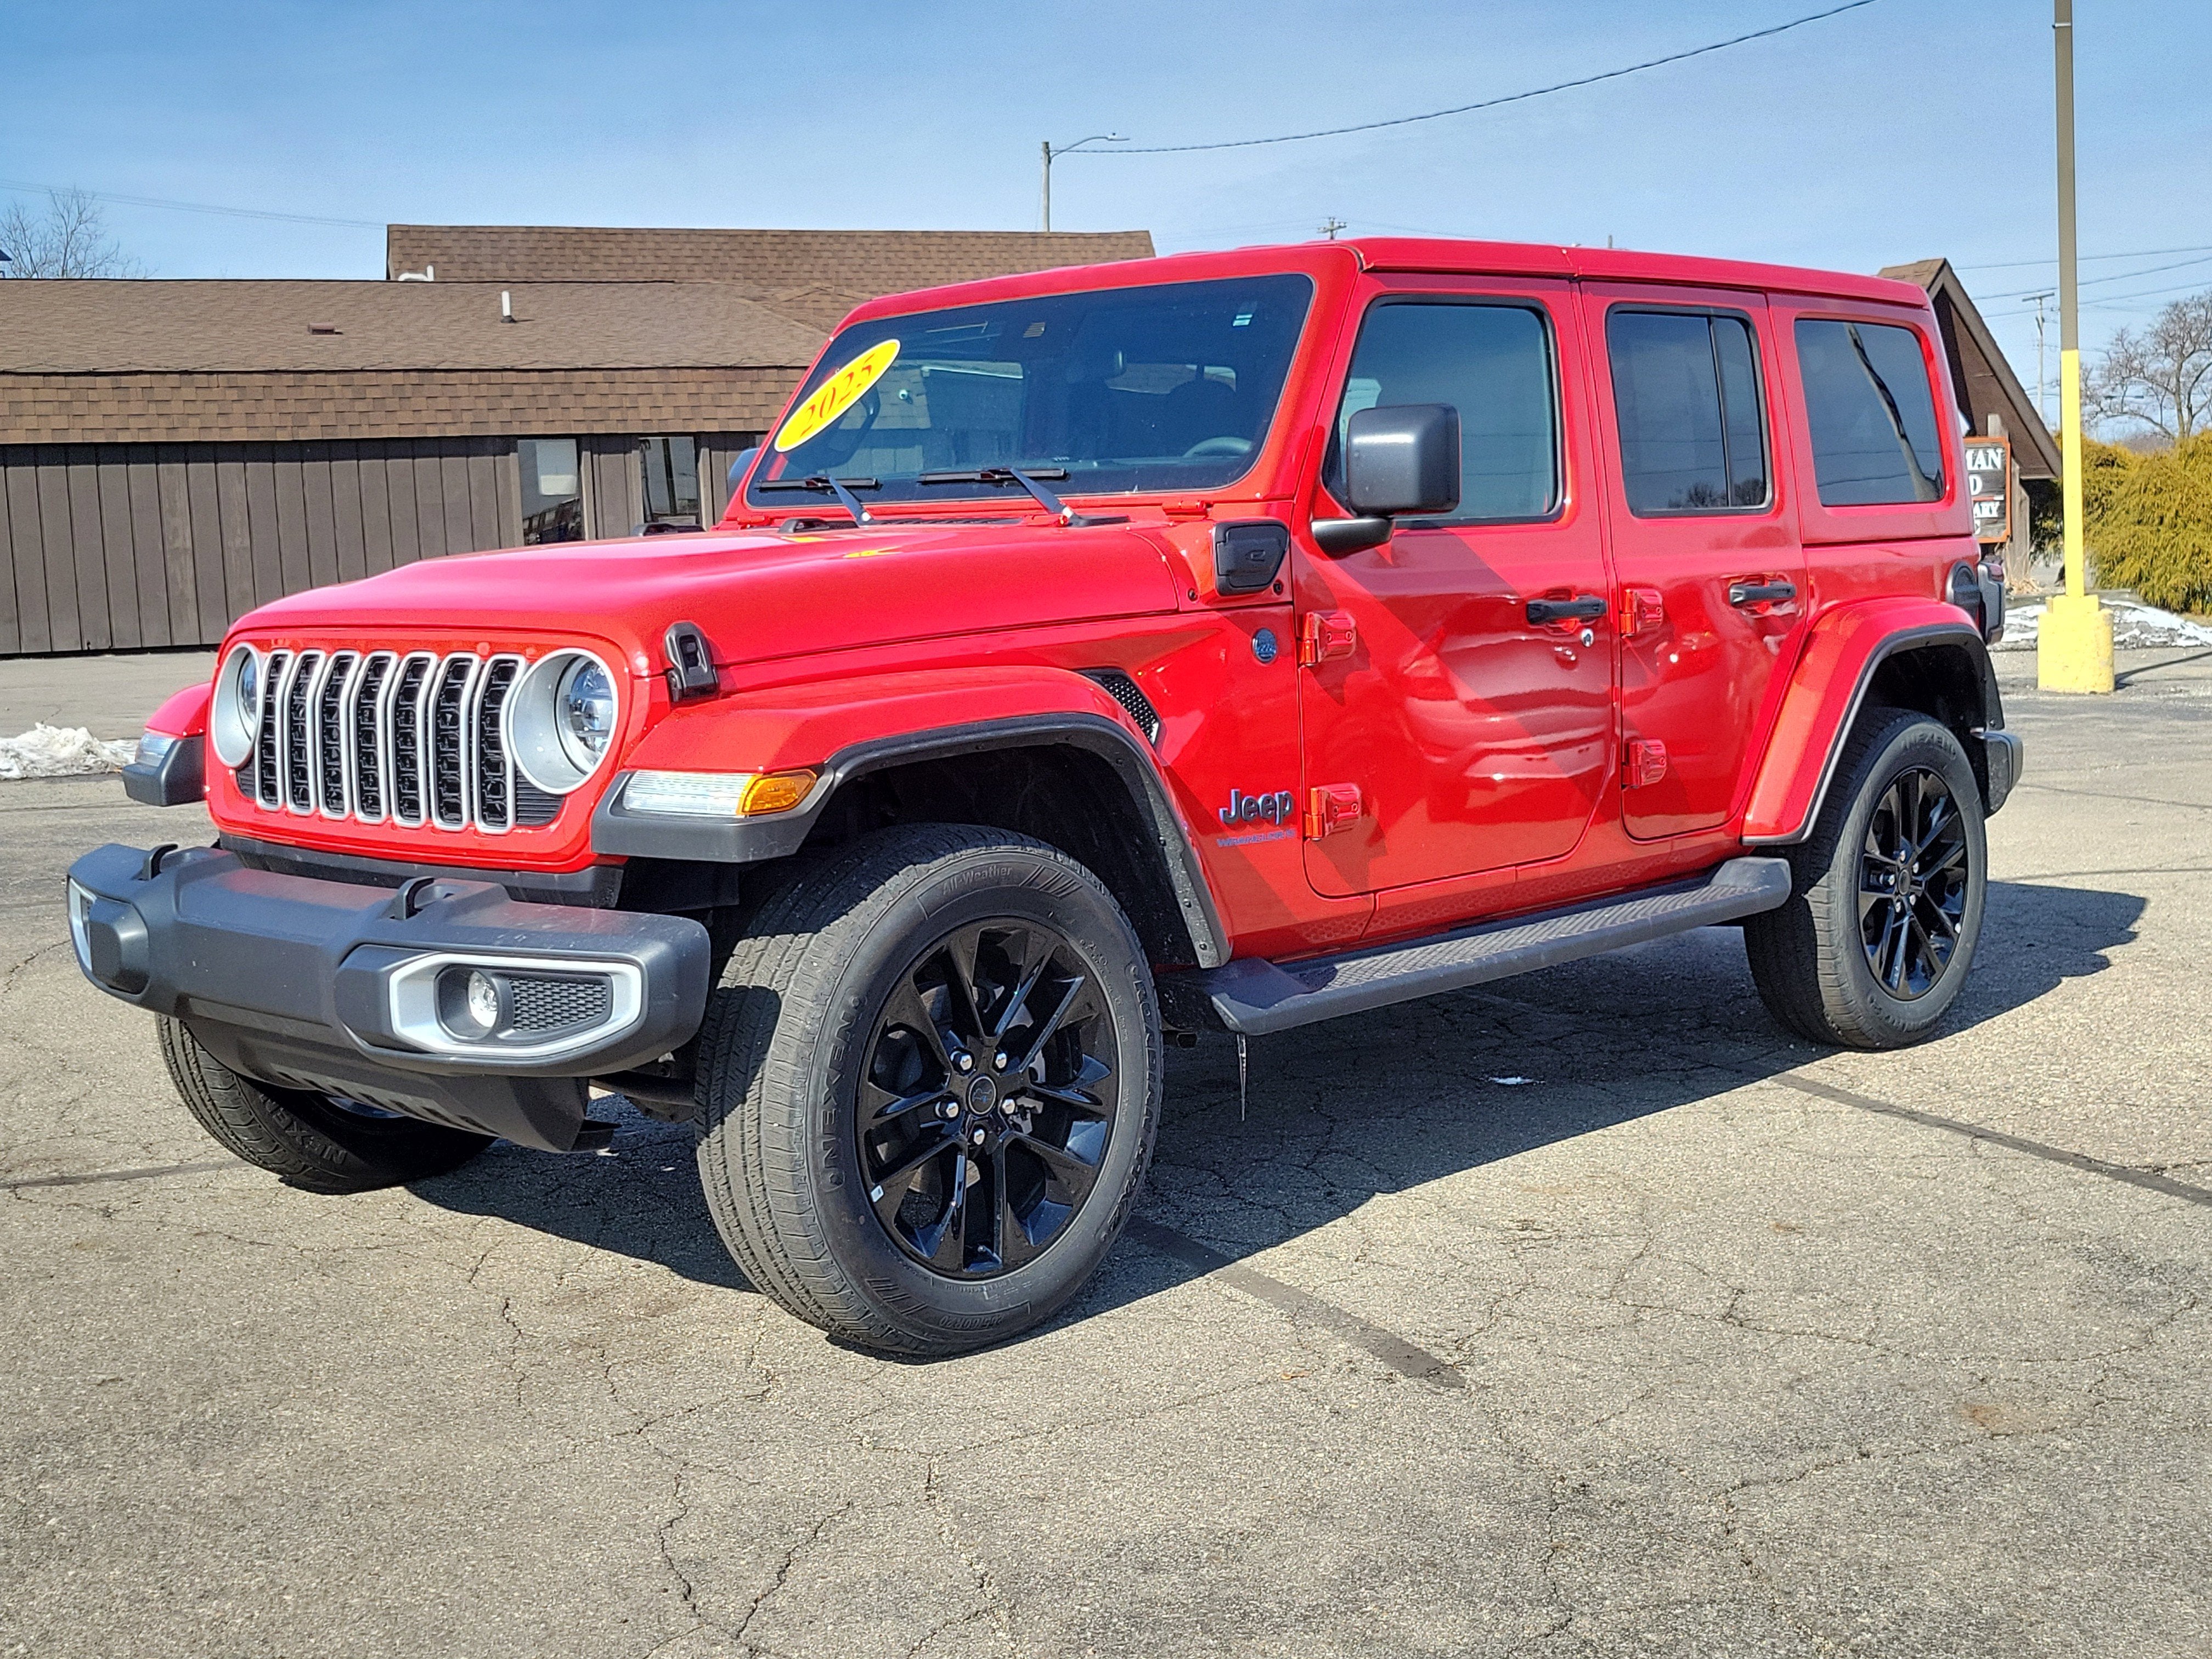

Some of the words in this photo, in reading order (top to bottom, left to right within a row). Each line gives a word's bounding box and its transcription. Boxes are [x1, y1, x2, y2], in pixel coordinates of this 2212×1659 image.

[799, 352, 876, 438] 2025
[1219, 788, 1294, 825] Jeep
[942, 865, 1013, 895] All-Weather
[822, 1009, 862, 1169] NEXEN
[1132, 979, 1158, 1131] ROADIAN
